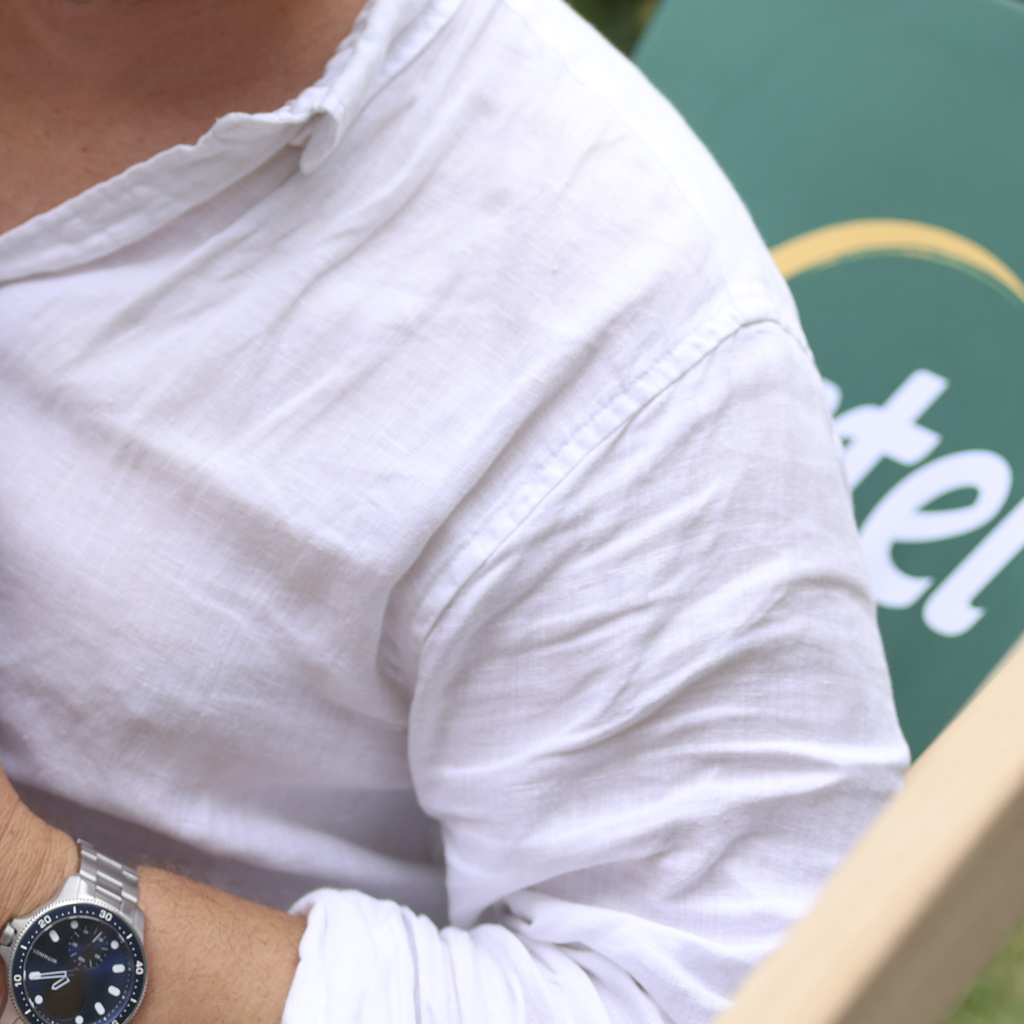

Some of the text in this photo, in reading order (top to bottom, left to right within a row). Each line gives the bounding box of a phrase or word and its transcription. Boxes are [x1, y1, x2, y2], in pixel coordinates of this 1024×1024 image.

[821, 368, 1024, 638] tel
[38, 915, 52, 929] 20
[98, 909, 113, 922] 30
[135, 960, 144, 975] 40
[13, 974, 22, 987] 10
